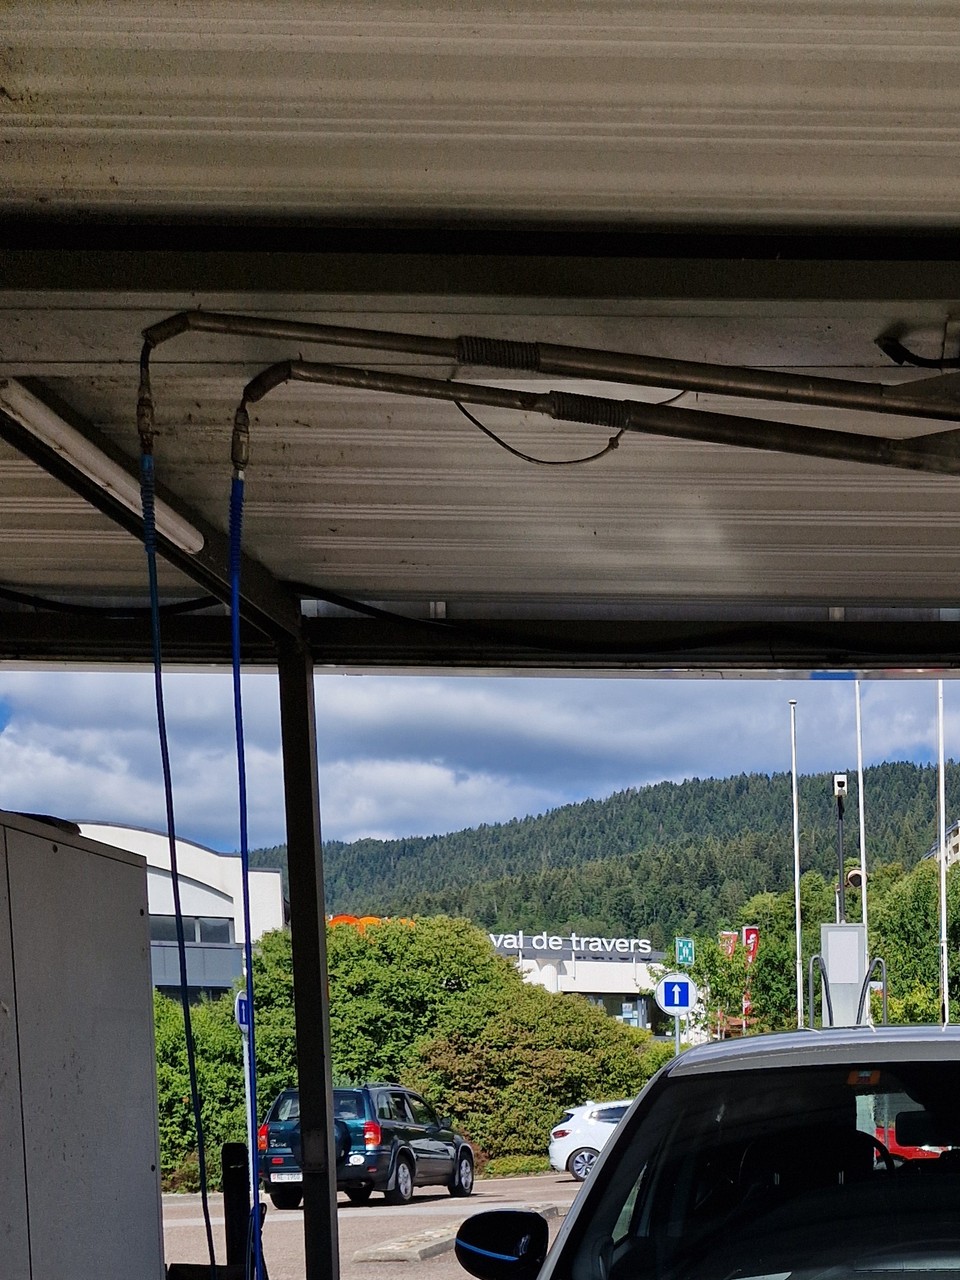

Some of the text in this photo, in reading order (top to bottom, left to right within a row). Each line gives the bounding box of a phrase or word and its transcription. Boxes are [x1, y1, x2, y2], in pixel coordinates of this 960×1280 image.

[489, 930, 652, 954] val de travers
